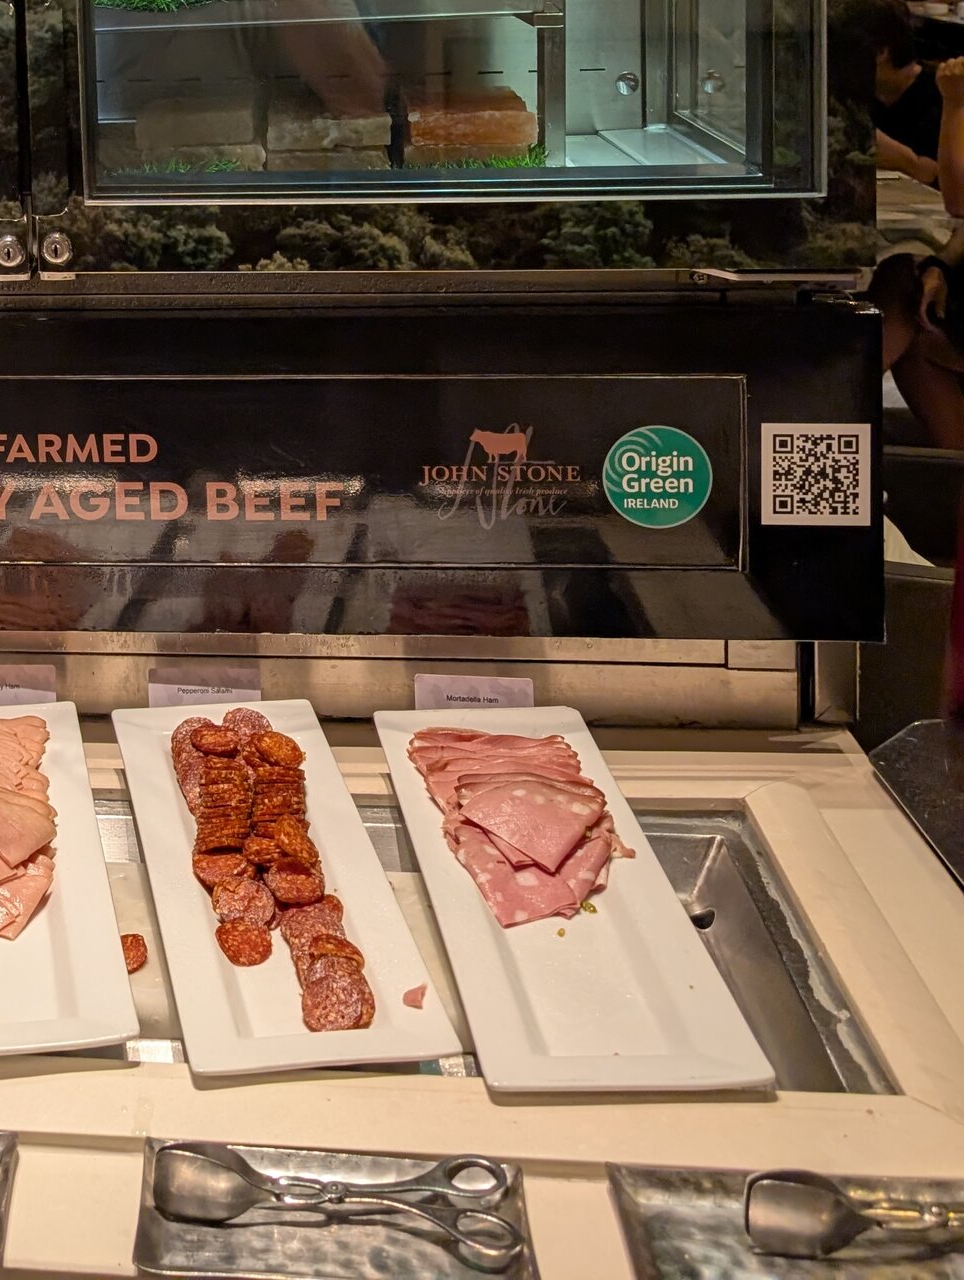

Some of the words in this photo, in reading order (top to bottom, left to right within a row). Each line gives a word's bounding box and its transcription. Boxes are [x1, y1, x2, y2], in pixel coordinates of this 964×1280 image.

[621, 451, 693, 476] Origin
[419, 465, 487, 486] JOHN
[497, 465, 581, 482] STONE
[622, 474, 693, 493] Green
[515, 486, 534, 495] Irish
[535, 487, 567, 496] produce
[30, 482, 188, 520] AGED
[207, 482, 343, 521] BEEF
[624, 498, 679, 509] IRELAND
[446, 694, 481, 703] Mortadella
